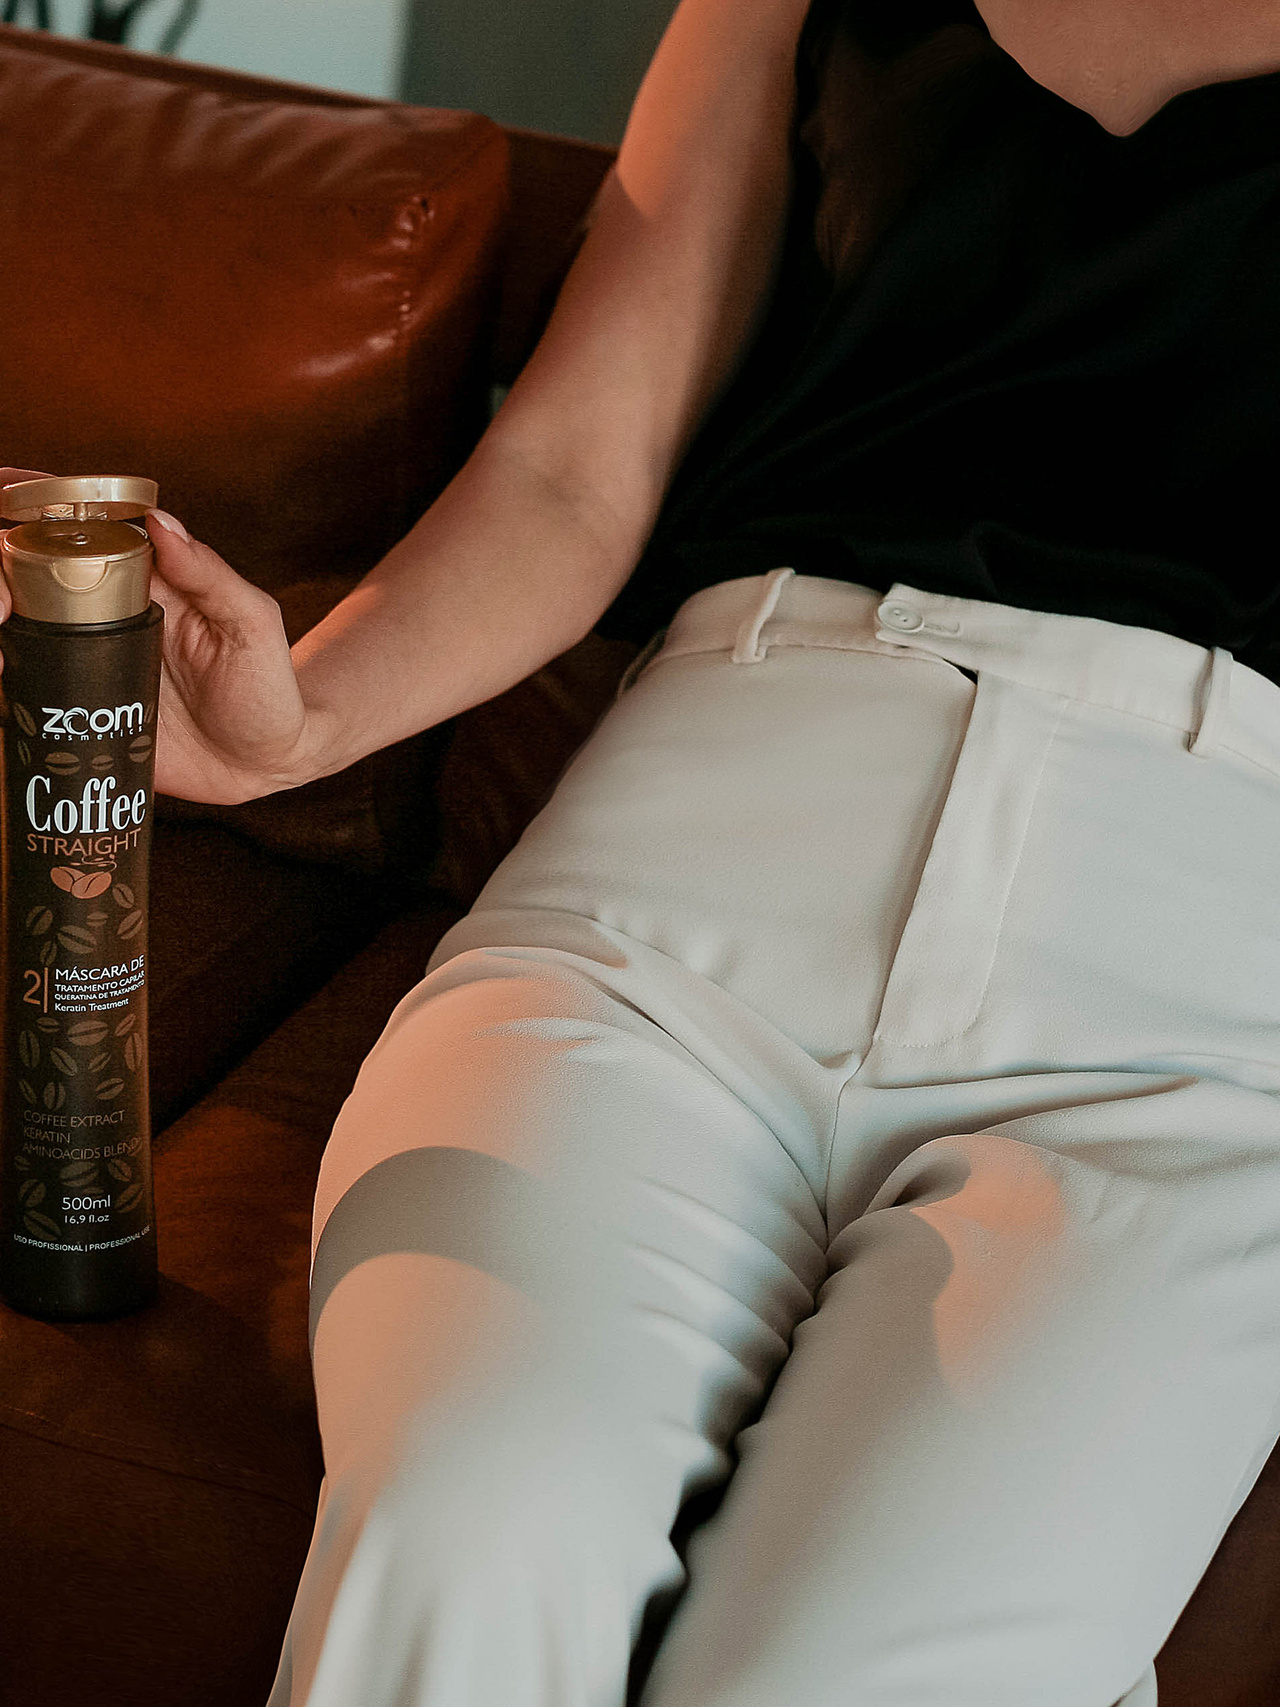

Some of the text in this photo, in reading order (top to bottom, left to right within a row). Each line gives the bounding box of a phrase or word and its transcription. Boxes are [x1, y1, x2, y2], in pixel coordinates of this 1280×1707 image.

[41, 701, 144, 736] zoom
[41, 725, 144, 741] cosmetics
[26, 775, 146, 834] Coffee
[27, 828, 142, 857] STRAIGHT
[55, 954, 145, 981] MÁSCARA DE
[23, 969, 42, 1006] 2
[54, 970, 145, 993] TRATAMENTO CAPILAR
[54, 993, 97, 1001] QUERATINA
[54, 998, 129, 1012] Keratin Treatment
[23, 1110, 125, 1128] COFFEE EXTRACT
[23, 1125, 70, 1144] KERATIN
[22, 1142, 100, 1160] AMINOACIDS
[61, 1194, 111, 1211] 500ml
[28, 1238, 84, 1252] PROFISSIONAL
[89, 1231, 141, 1251] PROFESSIONAL
